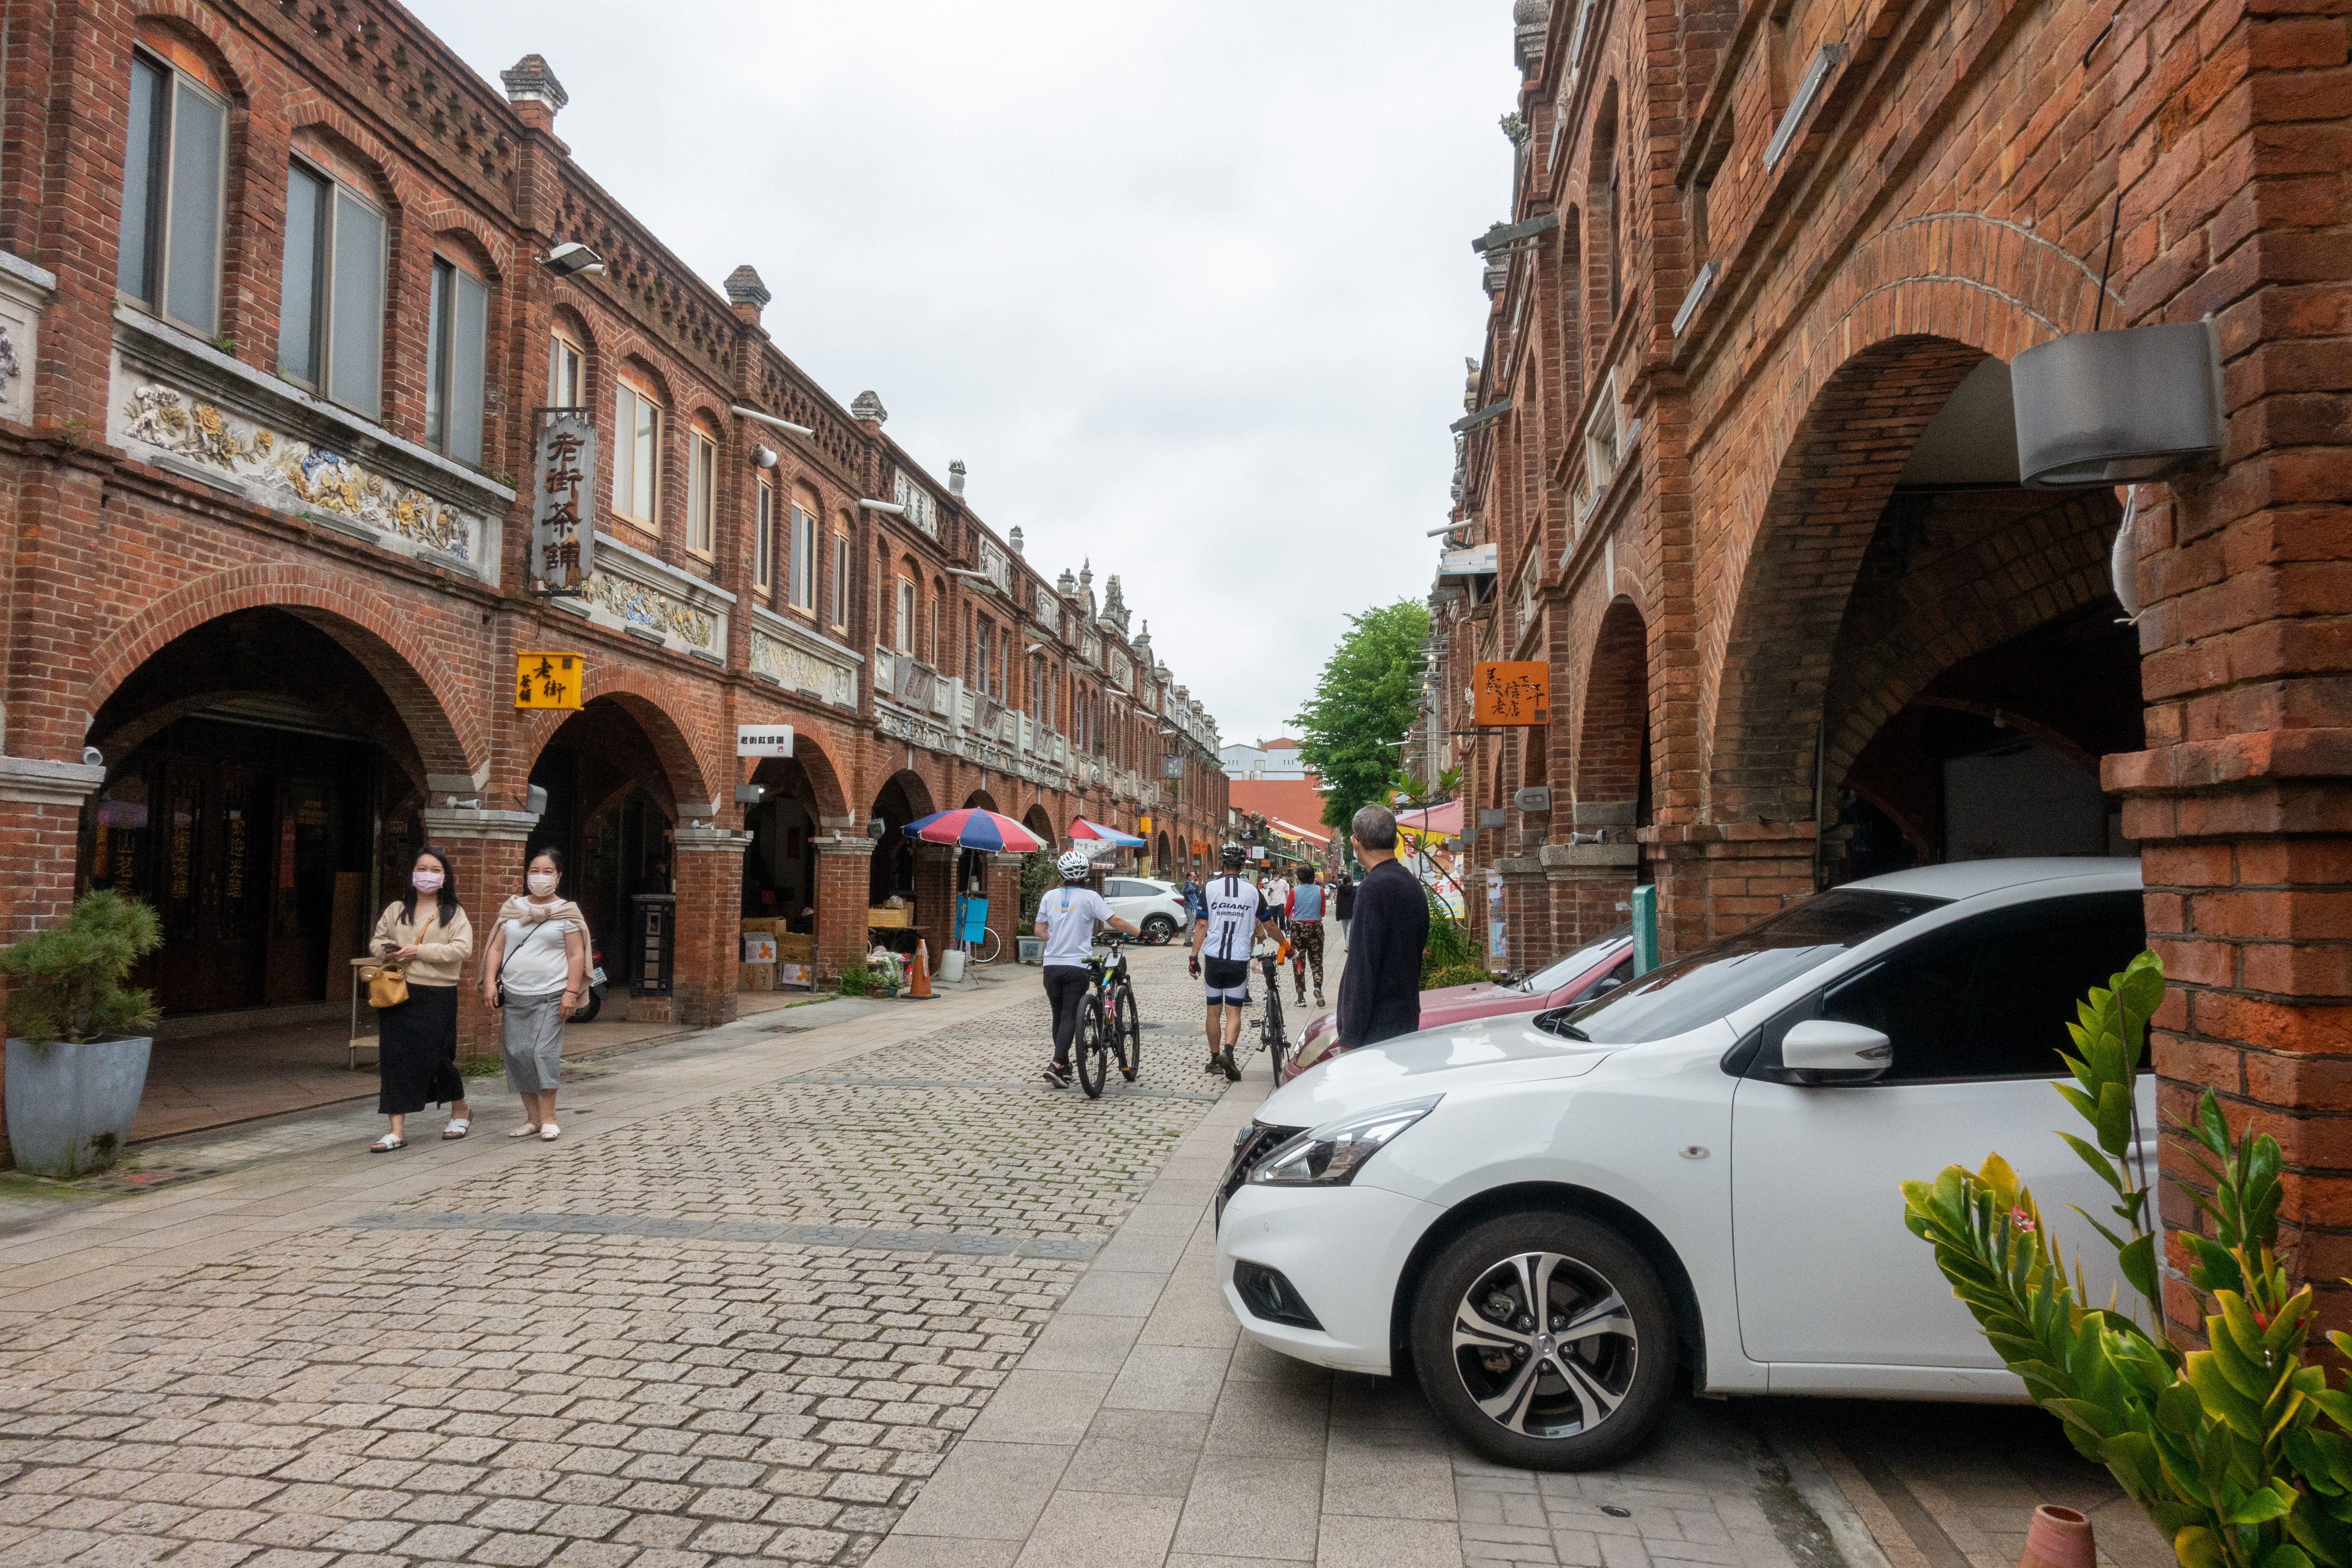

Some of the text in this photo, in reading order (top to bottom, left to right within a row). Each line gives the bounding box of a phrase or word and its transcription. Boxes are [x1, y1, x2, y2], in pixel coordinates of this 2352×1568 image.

[741, 736, 784, 744] 老街紅豆湯
[1219, 902, 1251, 911] GIANT
